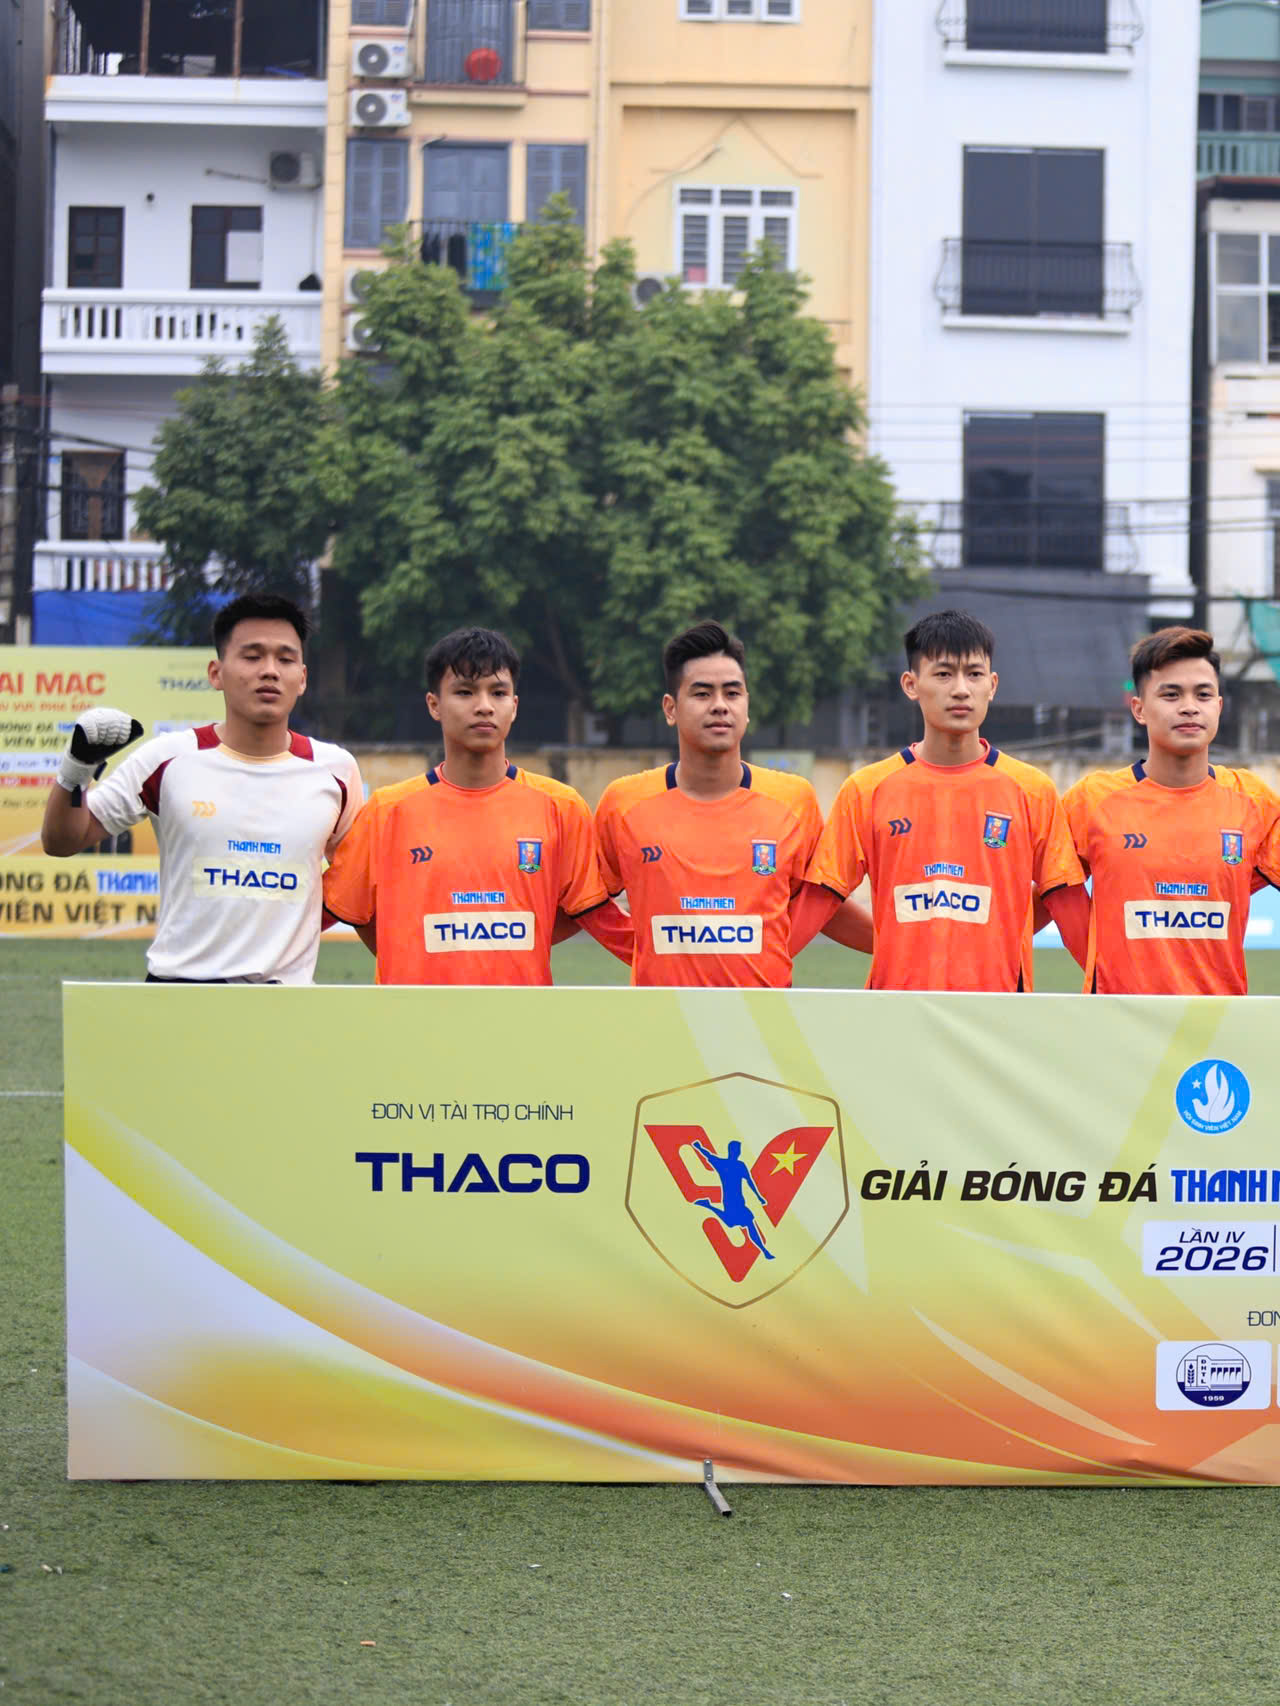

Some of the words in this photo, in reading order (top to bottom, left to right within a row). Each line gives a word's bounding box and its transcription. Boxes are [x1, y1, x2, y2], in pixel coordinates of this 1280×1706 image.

[203, 867, 298, 891] THACO
[904, 889, 981, 912] THACO
[1135, 910, 1225, 929] THACO
[434, 922, 526, 941] THACO
[660, 925, 754, 943] THACO
[370, 1102, 414, 1120] ĐƠN
[418, 1103, 435, 1123] VỊ
[440, 1100, 468, 1121] TÀI
[472, 1103, 510, 1124] TRỢ
[514, 1100, 574, 1121] CHÍNH
[355, 1151, 591, 1194] THACO
[860, 1159, 947, 1202] GIẢI
[959, 1163, 1086, 1203] BÓNG
[1098, 1163, 1158, 1203] ĐÁ
[1170, 1170, 1267, 1203] THANH
[1178, 1227, 1220, 1244] LẦN
[1225, 1230, 1246, 1244] IV
[1155, 1245, 1269, 1272] 2026
[1202, 1393, 1225, 1402] 1959
